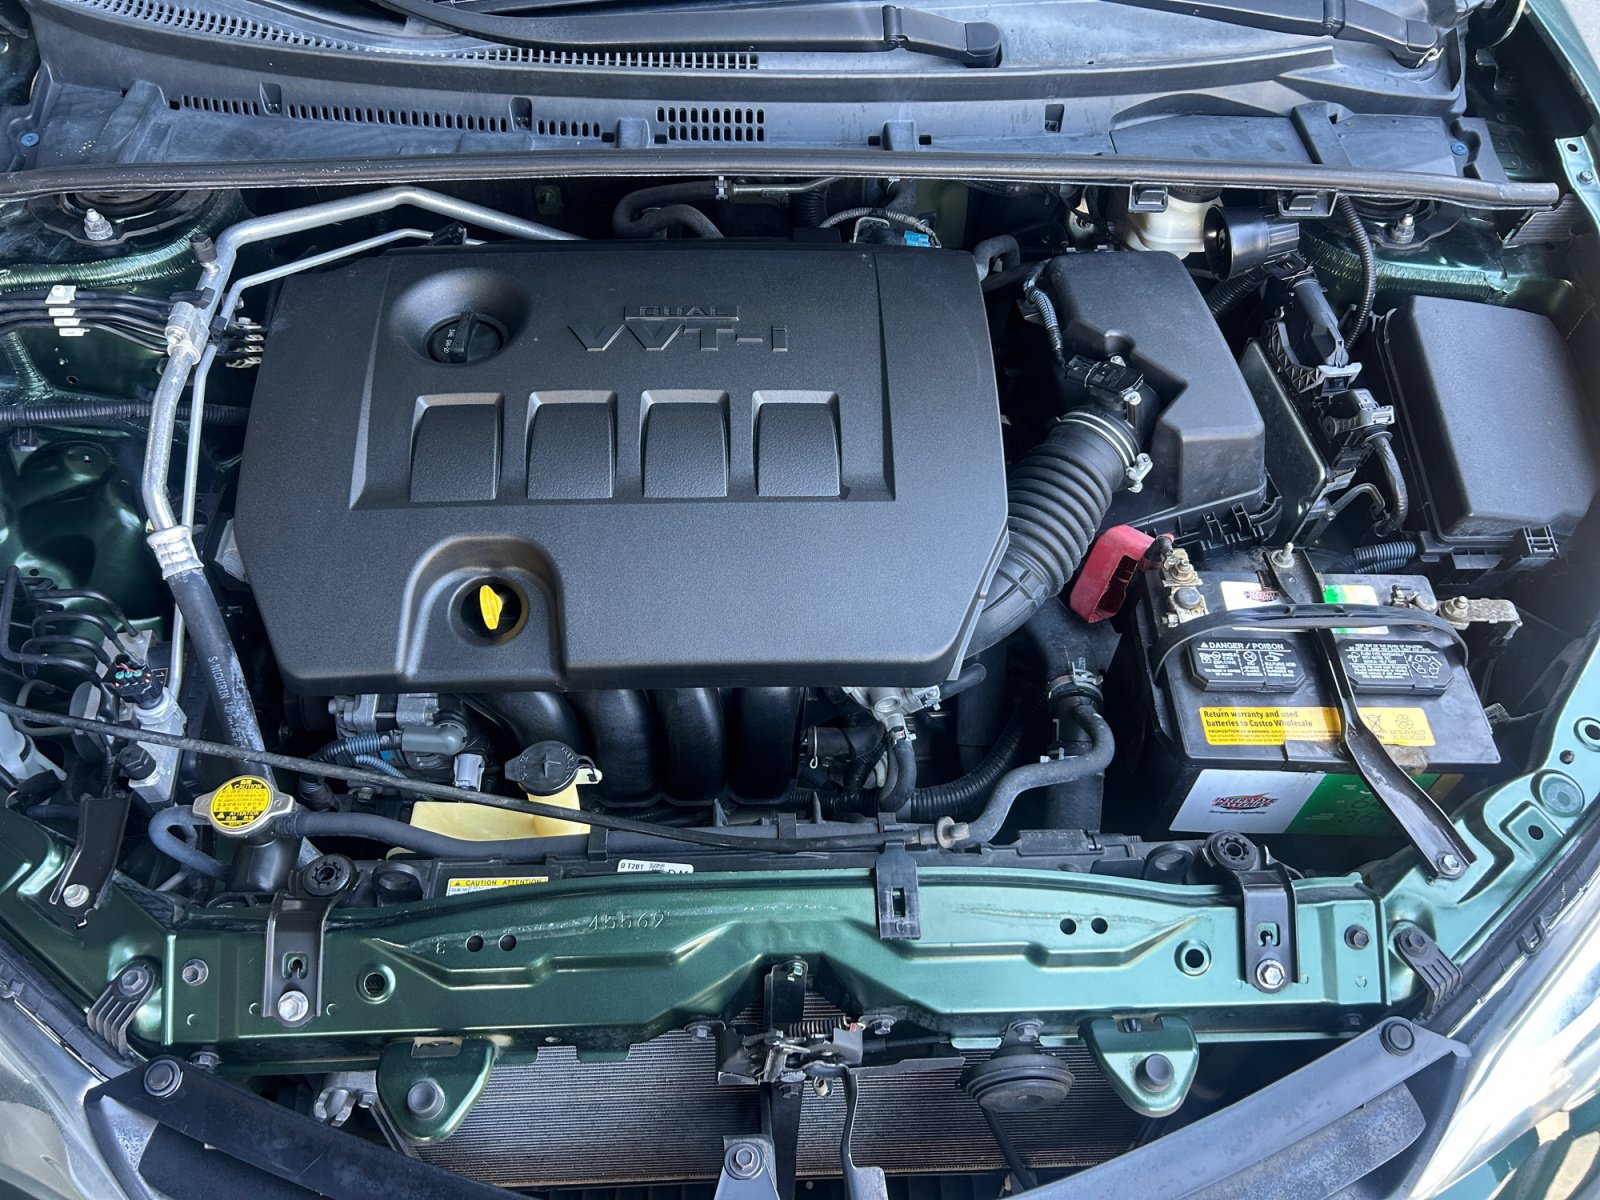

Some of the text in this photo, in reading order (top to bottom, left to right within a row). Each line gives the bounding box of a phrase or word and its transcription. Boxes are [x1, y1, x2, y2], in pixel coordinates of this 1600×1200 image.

[639, 306, 728, 316] DUAL
[1209, 642, 1244, 650] DANGER
[1252, 642, 1284, 650] POISON
[1231, 711, 1263, 719] warranty
